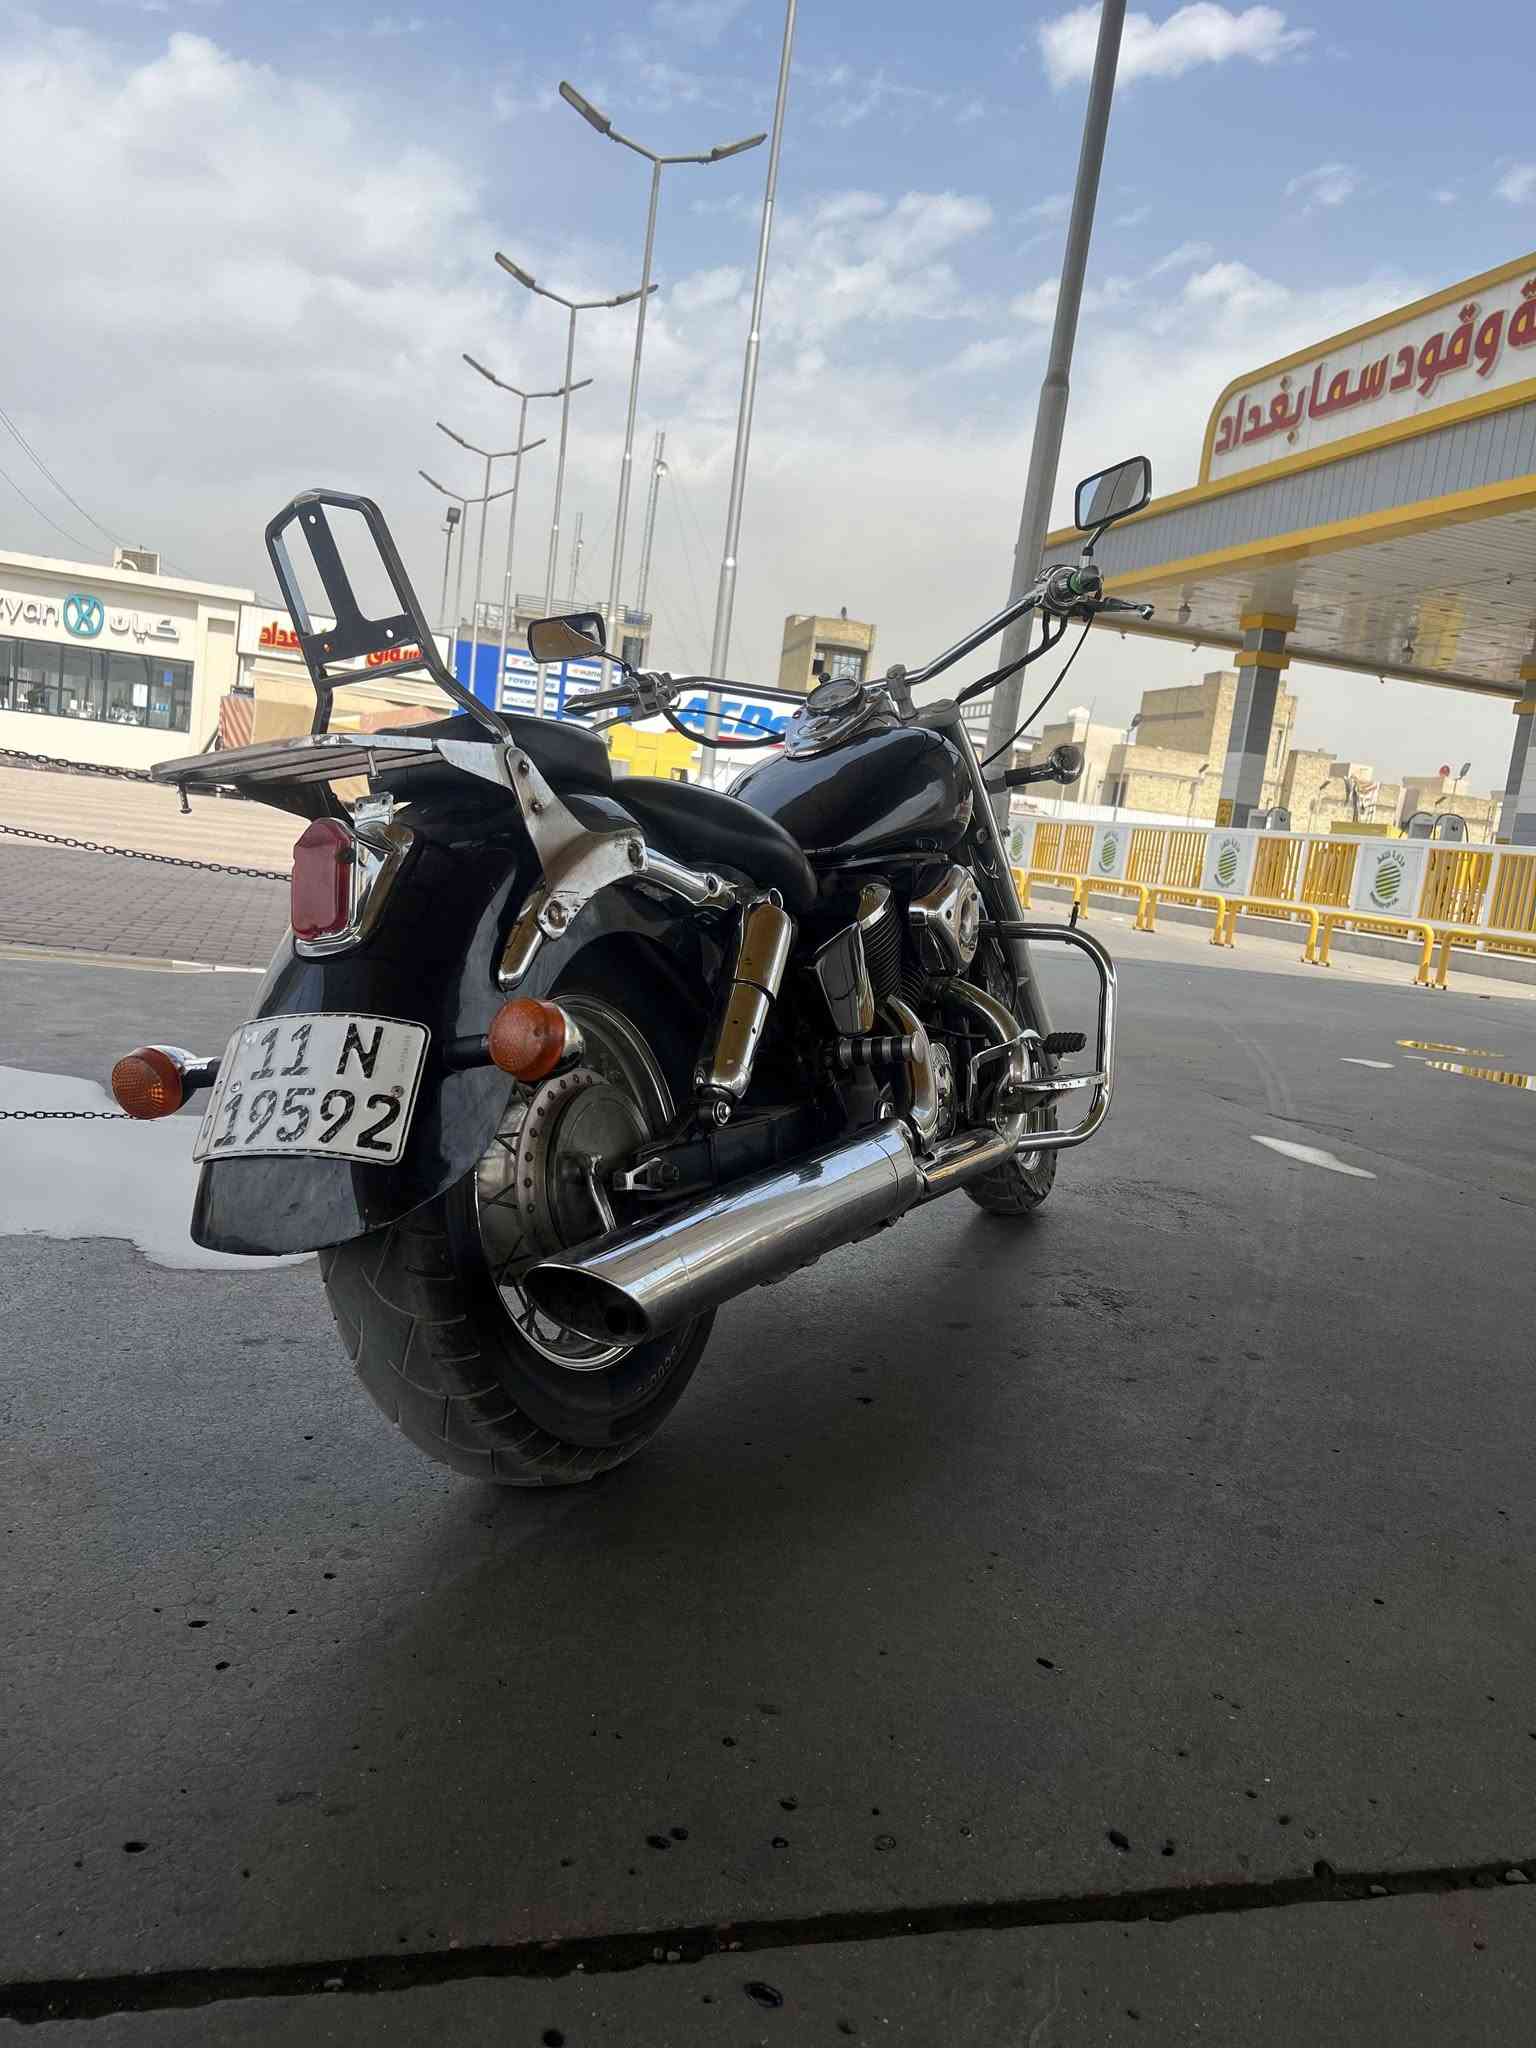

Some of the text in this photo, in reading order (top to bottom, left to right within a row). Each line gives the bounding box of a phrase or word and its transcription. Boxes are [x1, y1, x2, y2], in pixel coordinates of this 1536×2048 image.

[1214, 376, 1309, 456] بغداد
[251, 1023, 312, 1080] 11
[336, 1023, 384, 1079] N
[214, 1087, 401, 1151] 19592
